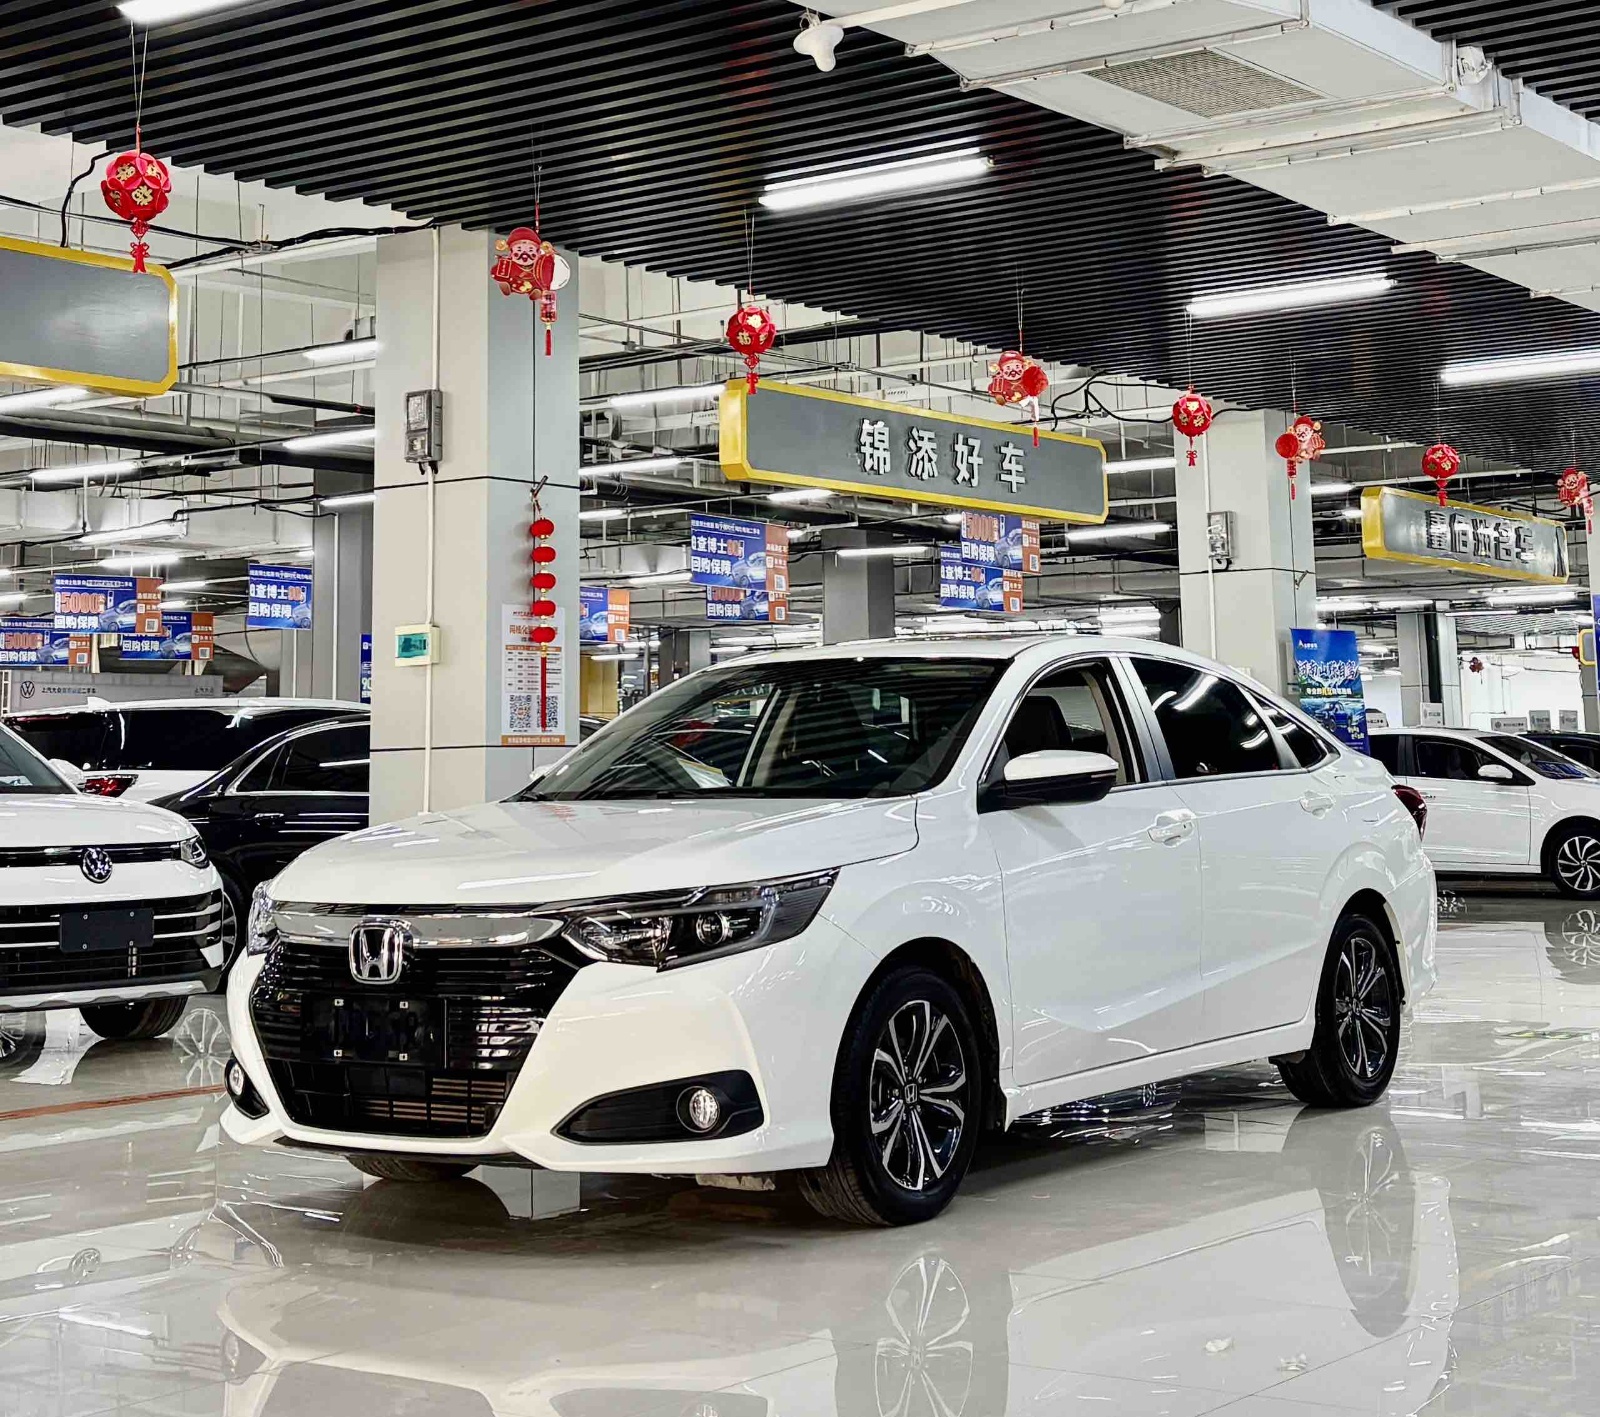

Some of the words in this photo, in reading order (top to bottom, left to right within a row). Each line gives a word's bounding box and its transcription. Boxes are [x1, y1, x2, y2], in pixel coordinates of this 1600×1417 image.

[860, 418, 1026, 494] 锦添好车
[691, 556, 732, 576] 回购保障
